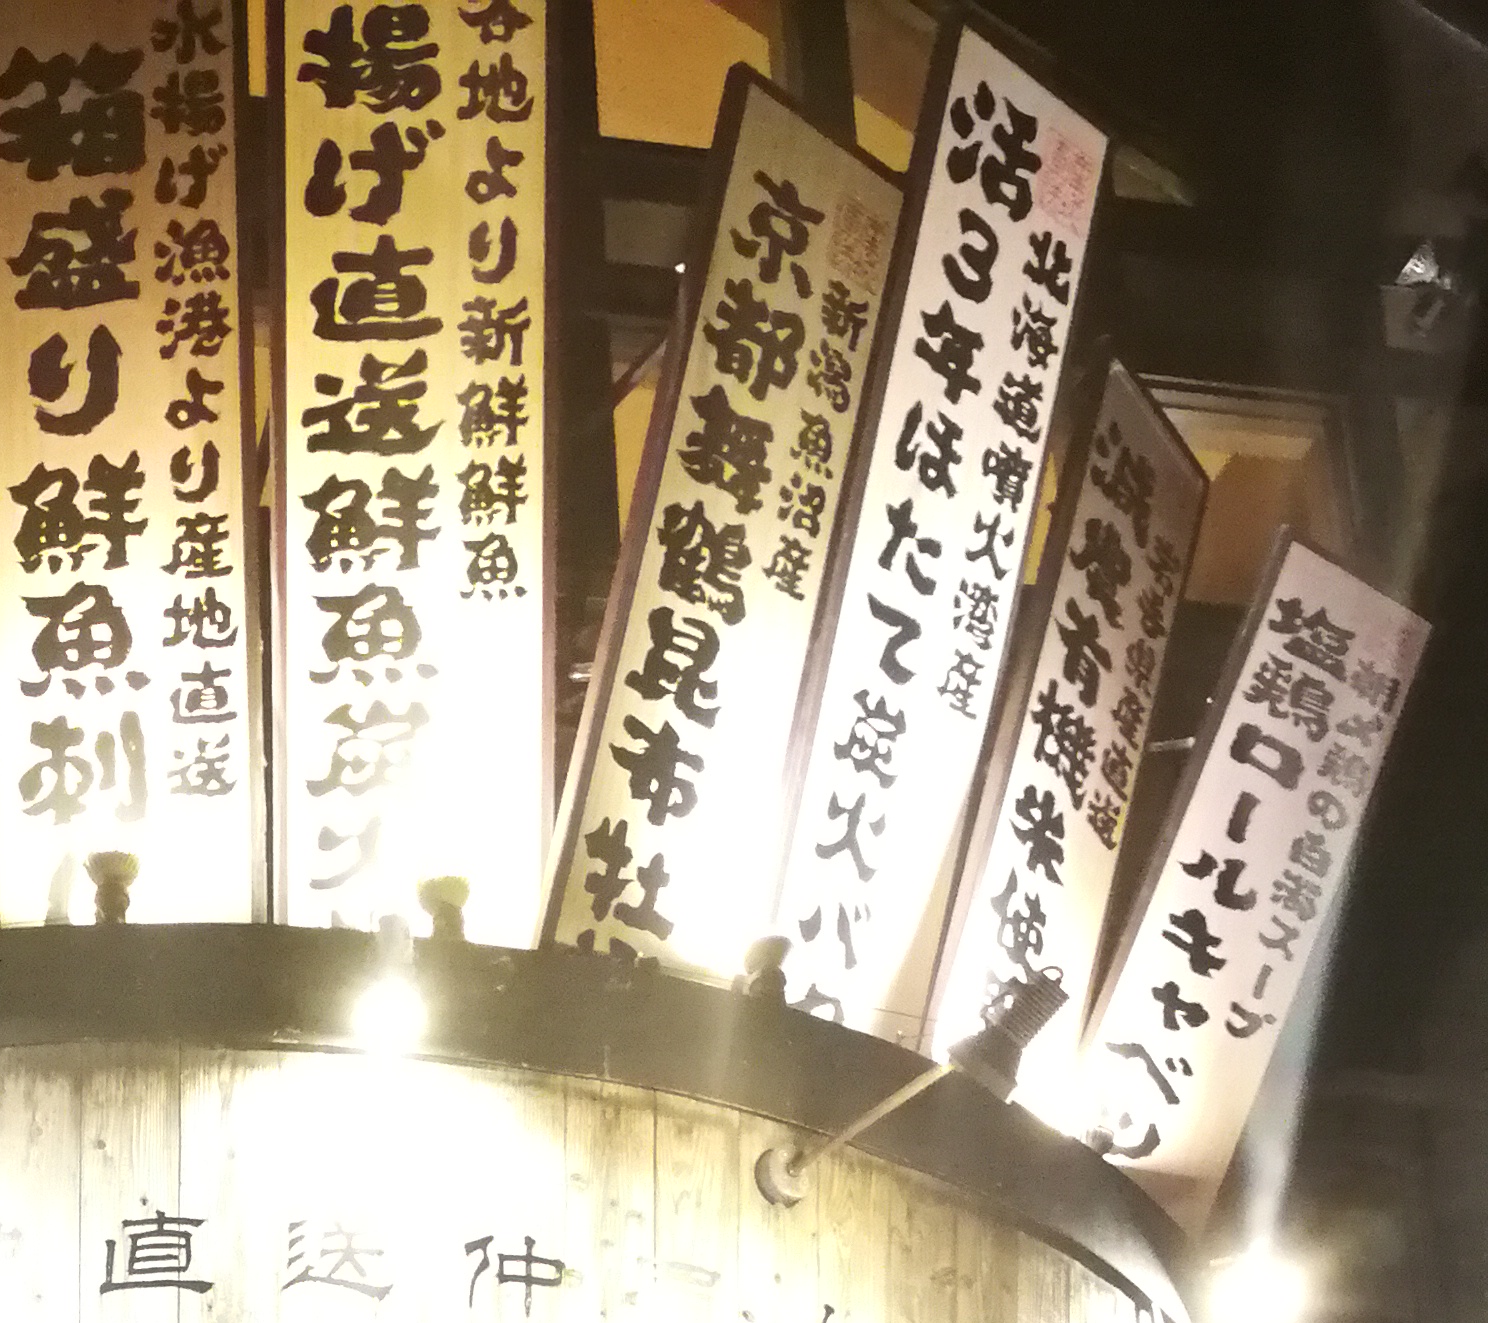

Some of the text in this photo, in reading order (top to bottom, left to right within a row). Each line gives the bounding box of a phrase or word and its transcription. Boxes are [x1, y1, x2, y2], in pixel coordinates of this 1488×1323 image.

[577, 169, 825, 957] 京都舞鶴昆布牡
[762, 280, 869, 601] 新潟魚沼産
[936, 231, 1072, 719] 北海道噴火湾産
